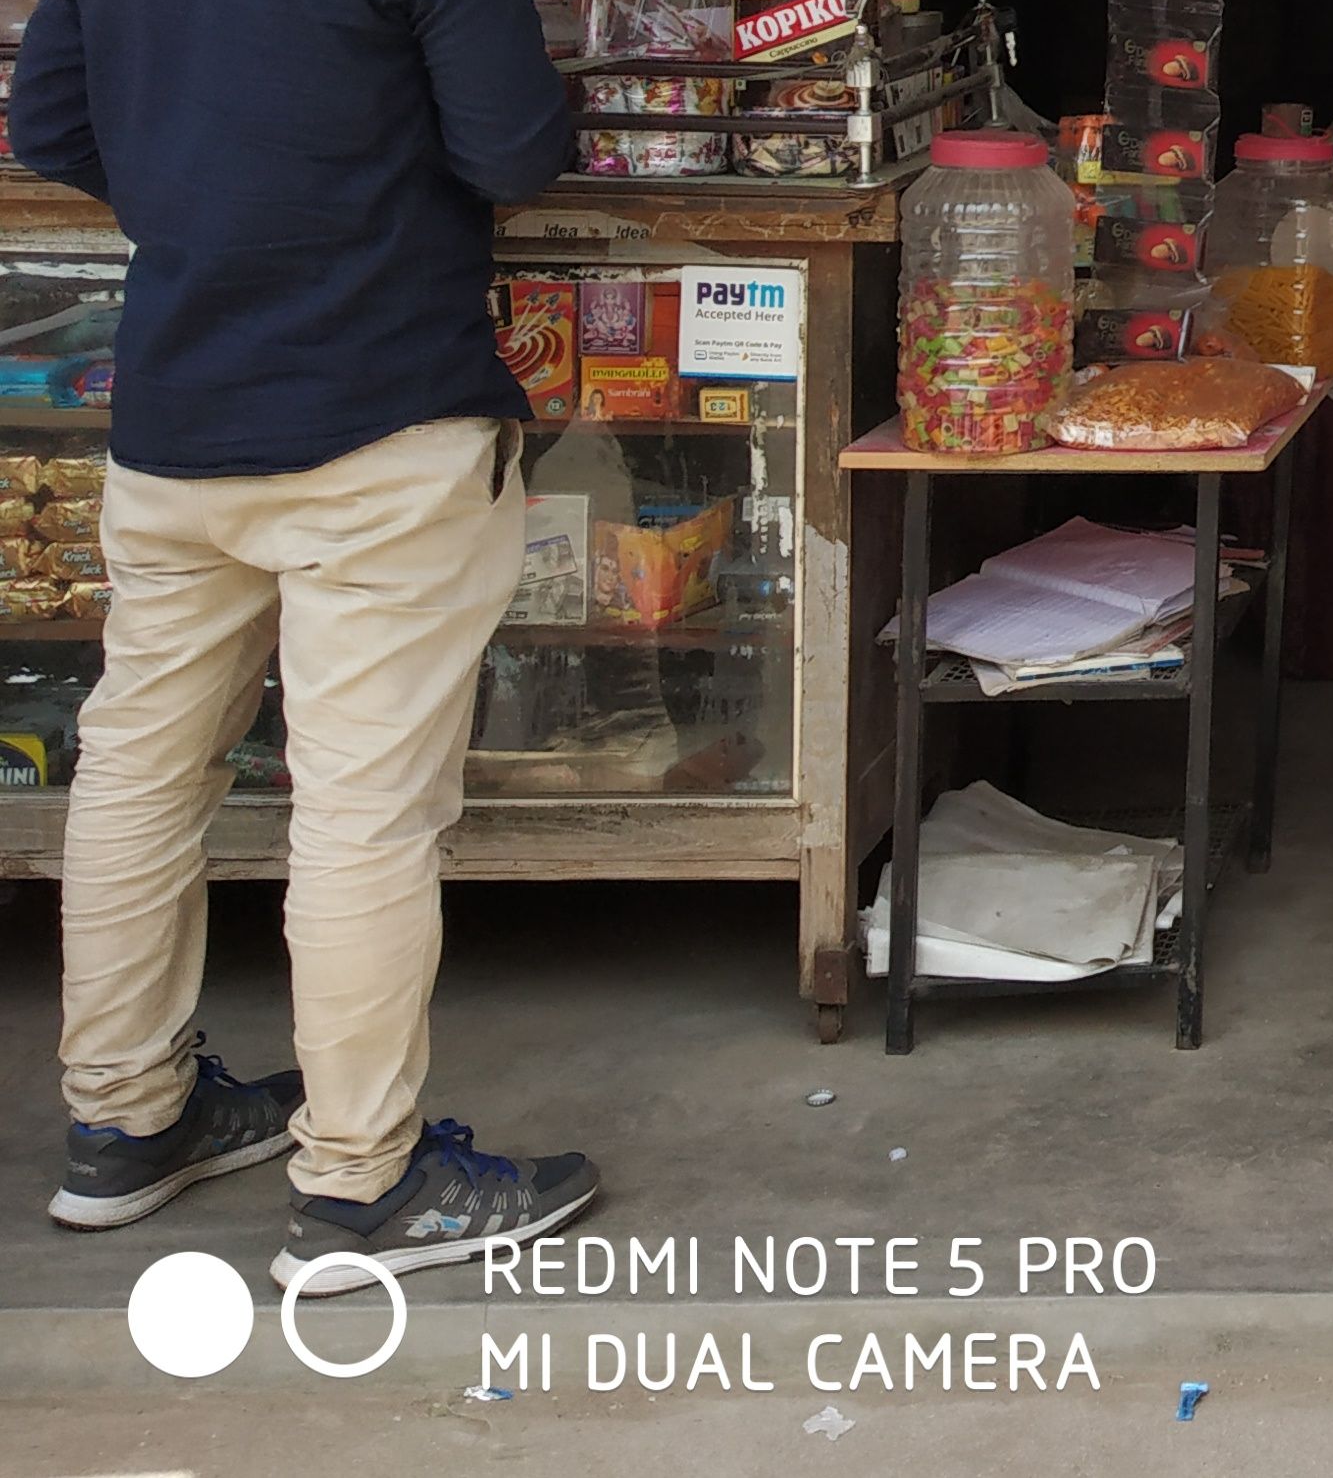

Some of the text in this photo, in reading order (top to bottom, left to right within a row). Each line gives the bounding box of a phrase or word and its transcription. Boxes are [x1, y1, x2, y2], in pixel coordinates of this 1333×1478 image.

[768, 34, 819, 60] Cappuccino
[696, 280, 785, 308] paytm
[695, 309, 784, 322] Accepted Here
